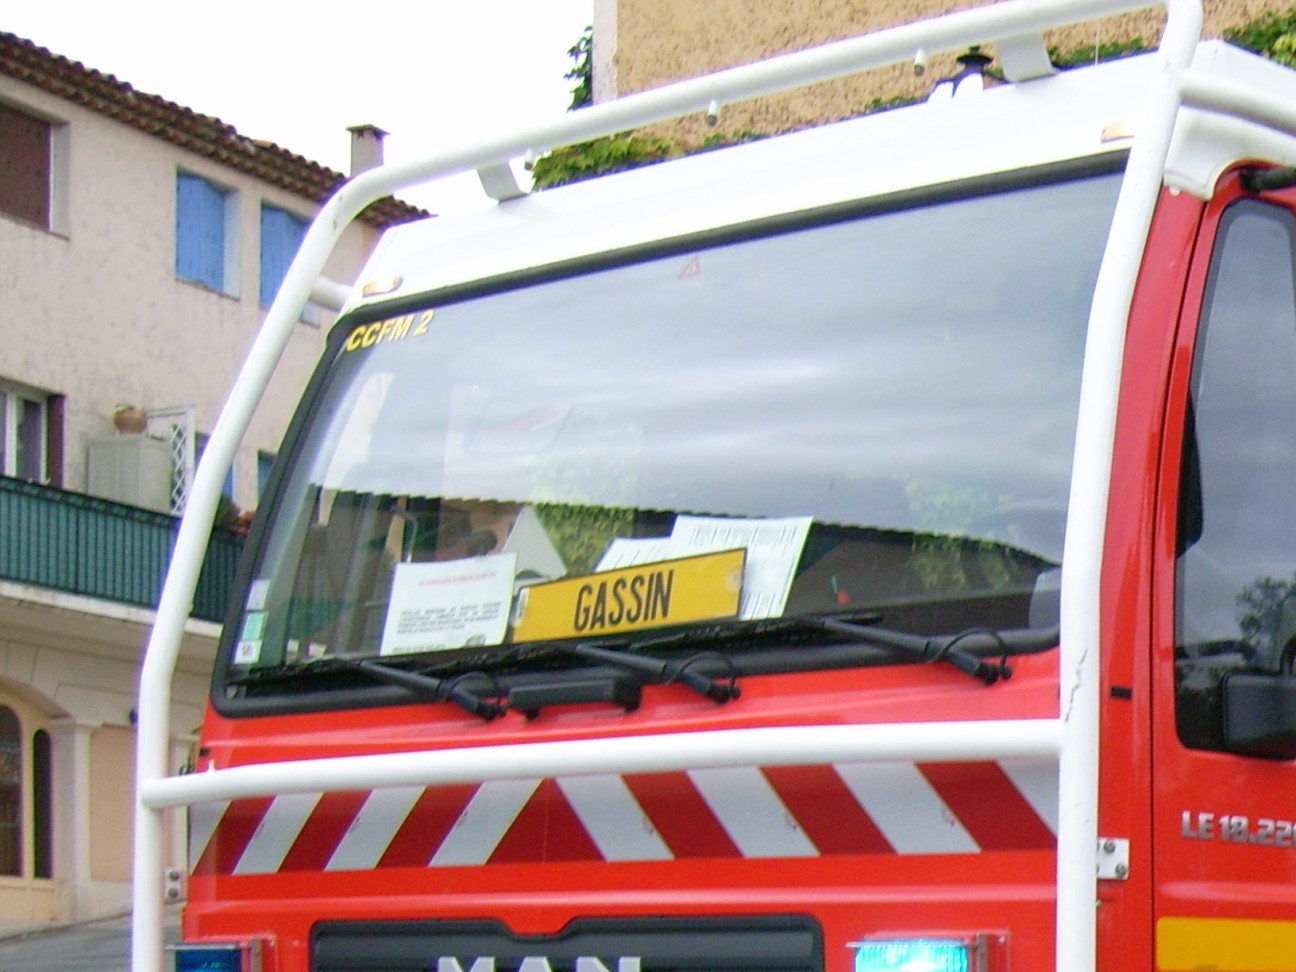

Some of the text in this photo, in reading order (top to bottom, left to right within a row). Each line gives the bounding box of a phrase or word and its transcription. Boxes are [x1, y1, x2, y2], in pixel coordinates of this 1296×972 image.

[347, 309, 434, 351] CCFM 2
[575, 570, 674, 632] GASSIN
[1182, 810, 1215, 839] LE
